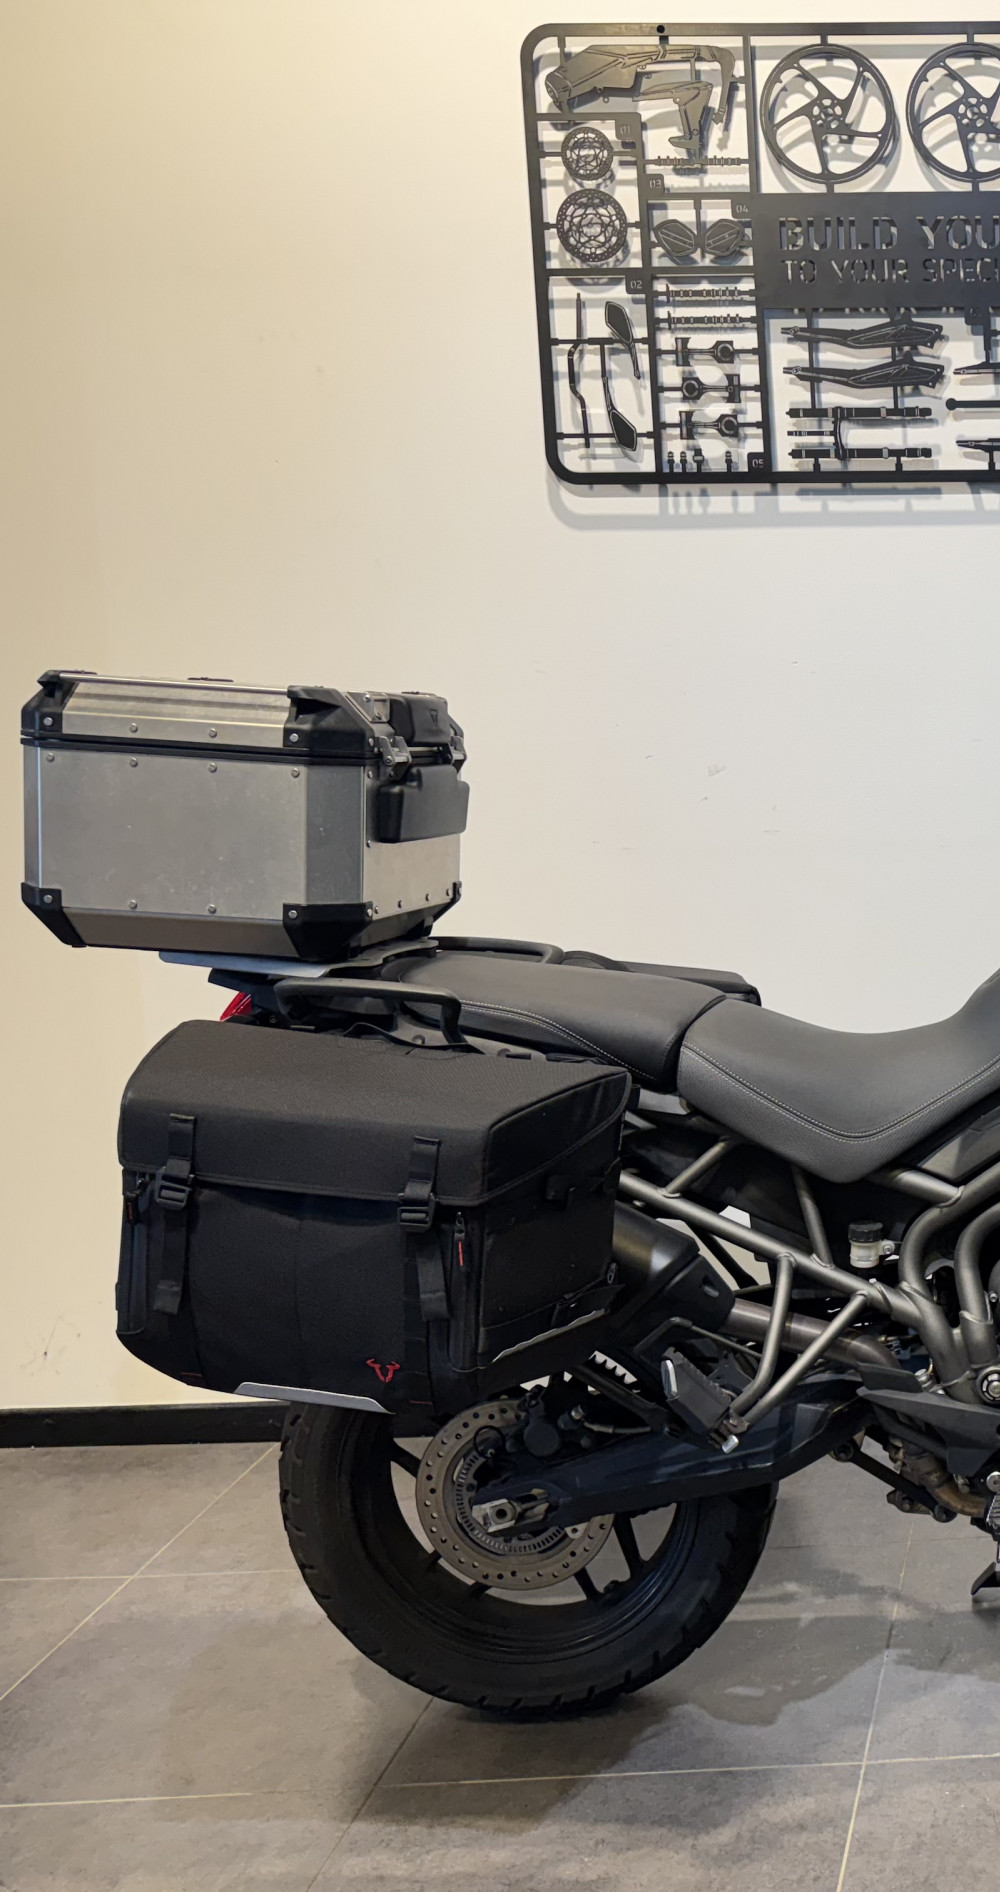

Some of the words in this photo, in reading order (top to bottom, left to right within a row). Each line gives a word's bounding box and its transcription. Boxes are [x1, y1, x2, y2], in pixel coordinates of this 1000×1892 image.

[620, 125, 631, 134] 01
[649, 180, 662, 189] 03
[736, 204, 748, 213] 04
[779, 216, 898, 251] BUILD
[780, 258, 817, 284] TO
[831, 258, 910, 284] YOUR
[630, 279, 643, 289] 02
[752, 459, 764, 468] 05
